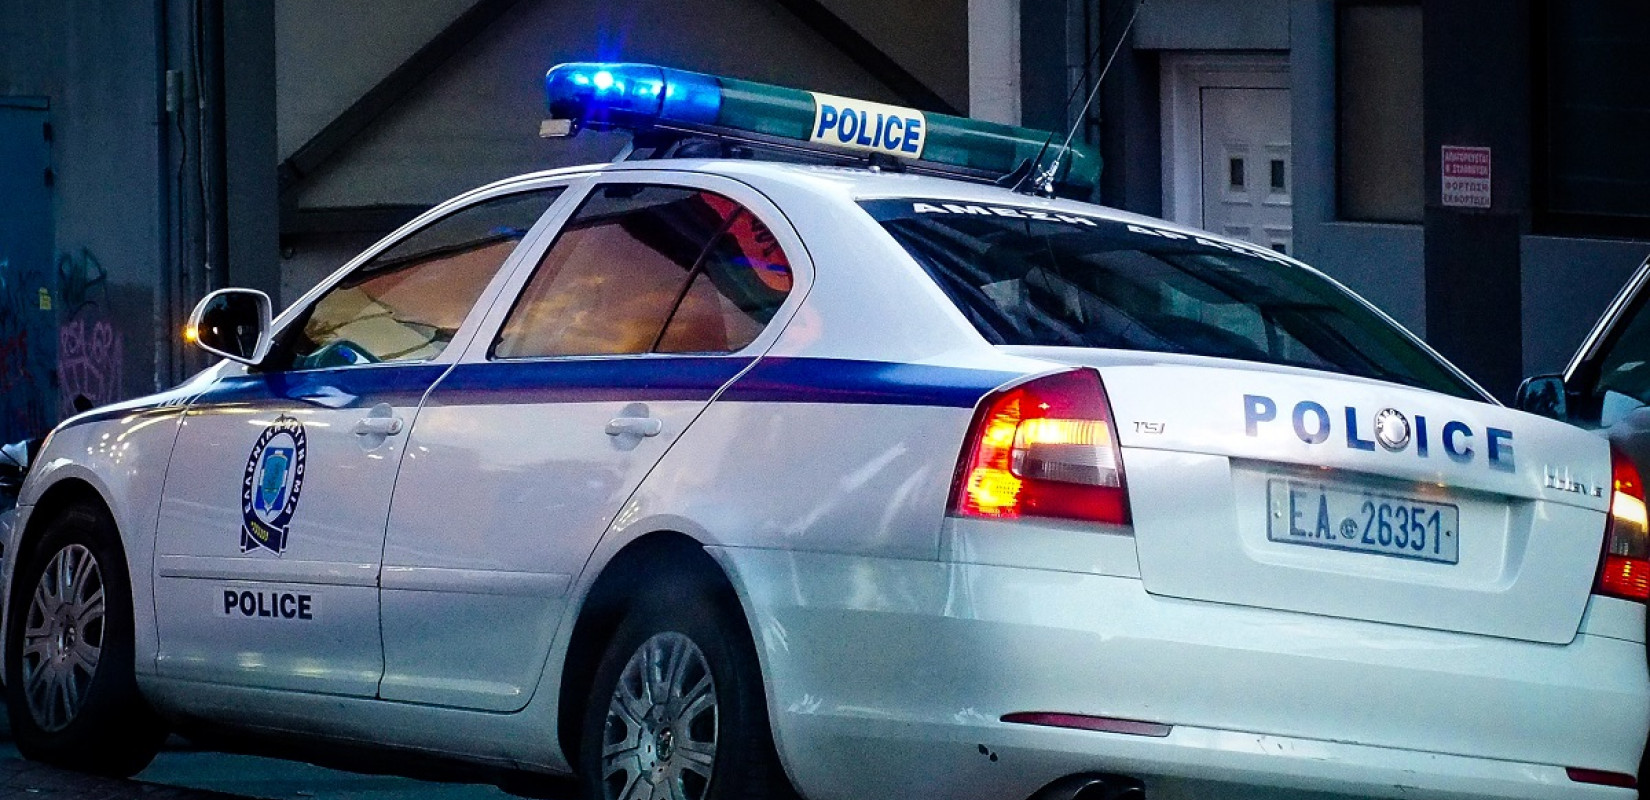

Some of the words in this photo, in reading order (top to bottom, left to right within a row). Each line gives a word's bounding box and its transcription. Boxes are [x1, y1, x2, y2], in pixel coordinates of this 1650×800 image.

[816, 103, 921, 153] POLICE
[1243, 394, 1515, 473] POLICE
[1361, 501, 1441, 554] 26351
[223, 590, 313, 620] POLICE
